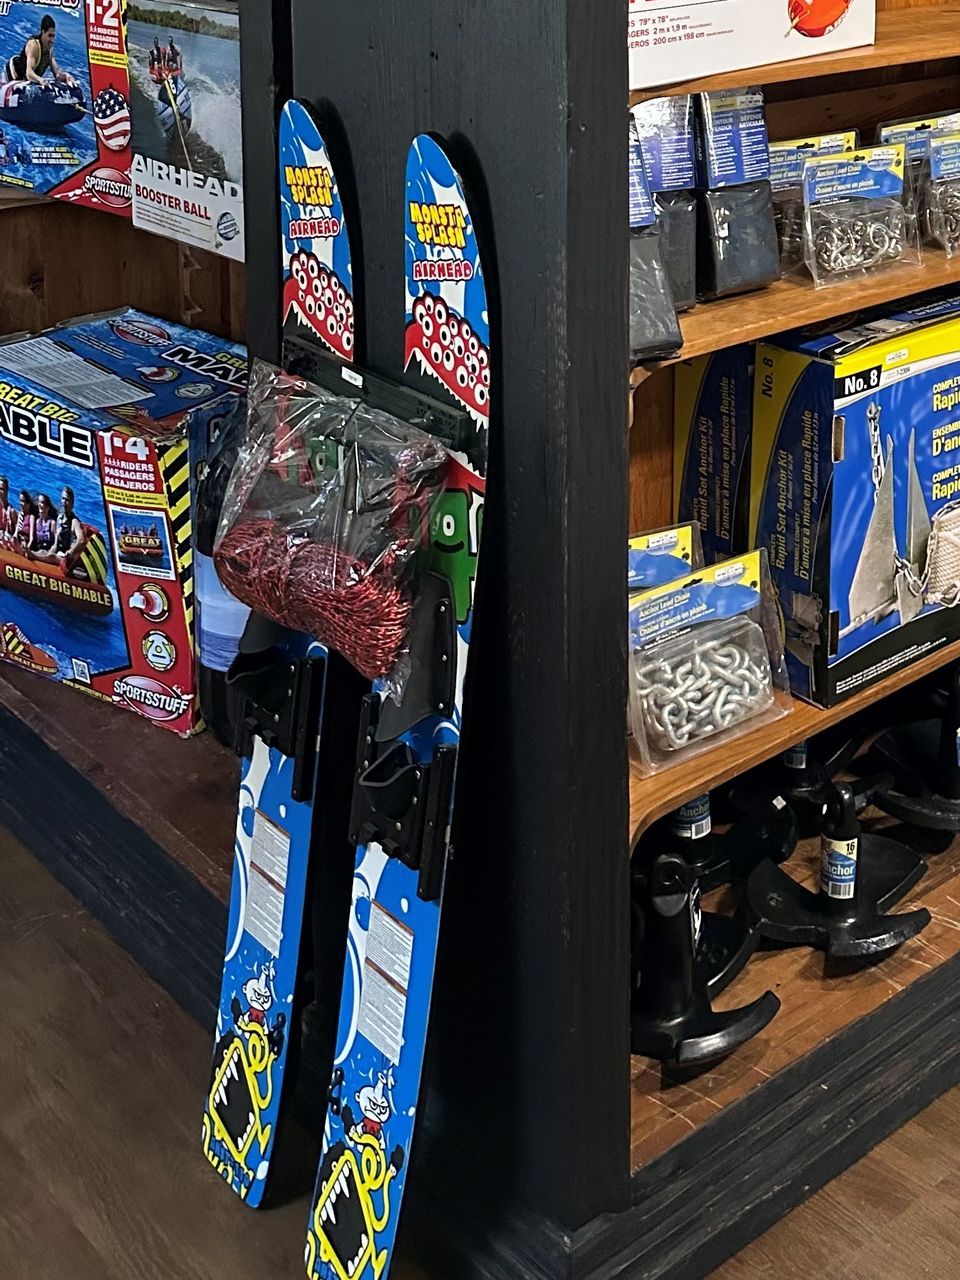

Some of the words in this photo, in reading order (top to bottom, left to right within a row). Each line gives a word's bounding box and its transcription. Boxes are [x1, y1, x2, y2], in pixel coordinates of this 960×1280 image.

[653, 37, 666, 45] 200
[85, 175, 132, 198] SPORTSSTU
[131, 153, 243, 198] AIRHEAD
[285, 166, 333, 188] MONSTA
[136, 184, 182, 211] BOOSTER
[184, 200, 211, 220] BALL
[291, 185, 333, 206] SPLASH
[289, 217, 340, 239] AIRHEAD
[409, 202, 466, 228] MONSTA
[416, 222, 466, 248] SPLASH
[413, 260, 473, 281] AIRHEAD
[762, 357, 774, 368] 8
[761, 370, 773, 398] No.
[845, 376, 867, 395] No.
[870, 369, 878, 387] 8
[0, 382, 44, 410] REAT
[41, 402, 80, 423] BIG
[802, 410, 813, 448] Rapide
[98, 431, 149, 461] 1-4
[778, 449, 788, 469] Kit
[105, 467, 155, 481] PASSAGERS
[120, 461, 154, 472] RIDERS
[802, 450, 813, 482] place
[105, 476, 155, 491] PASAJEROS
[777, 469, 788, 510] Anchor
[802, 482, 811, 498] en
[776, 518, 786, 534] Set
[801, 499, 811, 529] mise
[776, 541, 786, 569] Rapid
[800, 541, 811, 580] D'ancre
[5, 565, 47, 588] GREAT
[49, 580, 71, 595] BIG
[72, 585, 112, 607] MABLE
[113, 679, 189, 714] SPORTSSTUFF
[845, 841, 855, 852] 16
